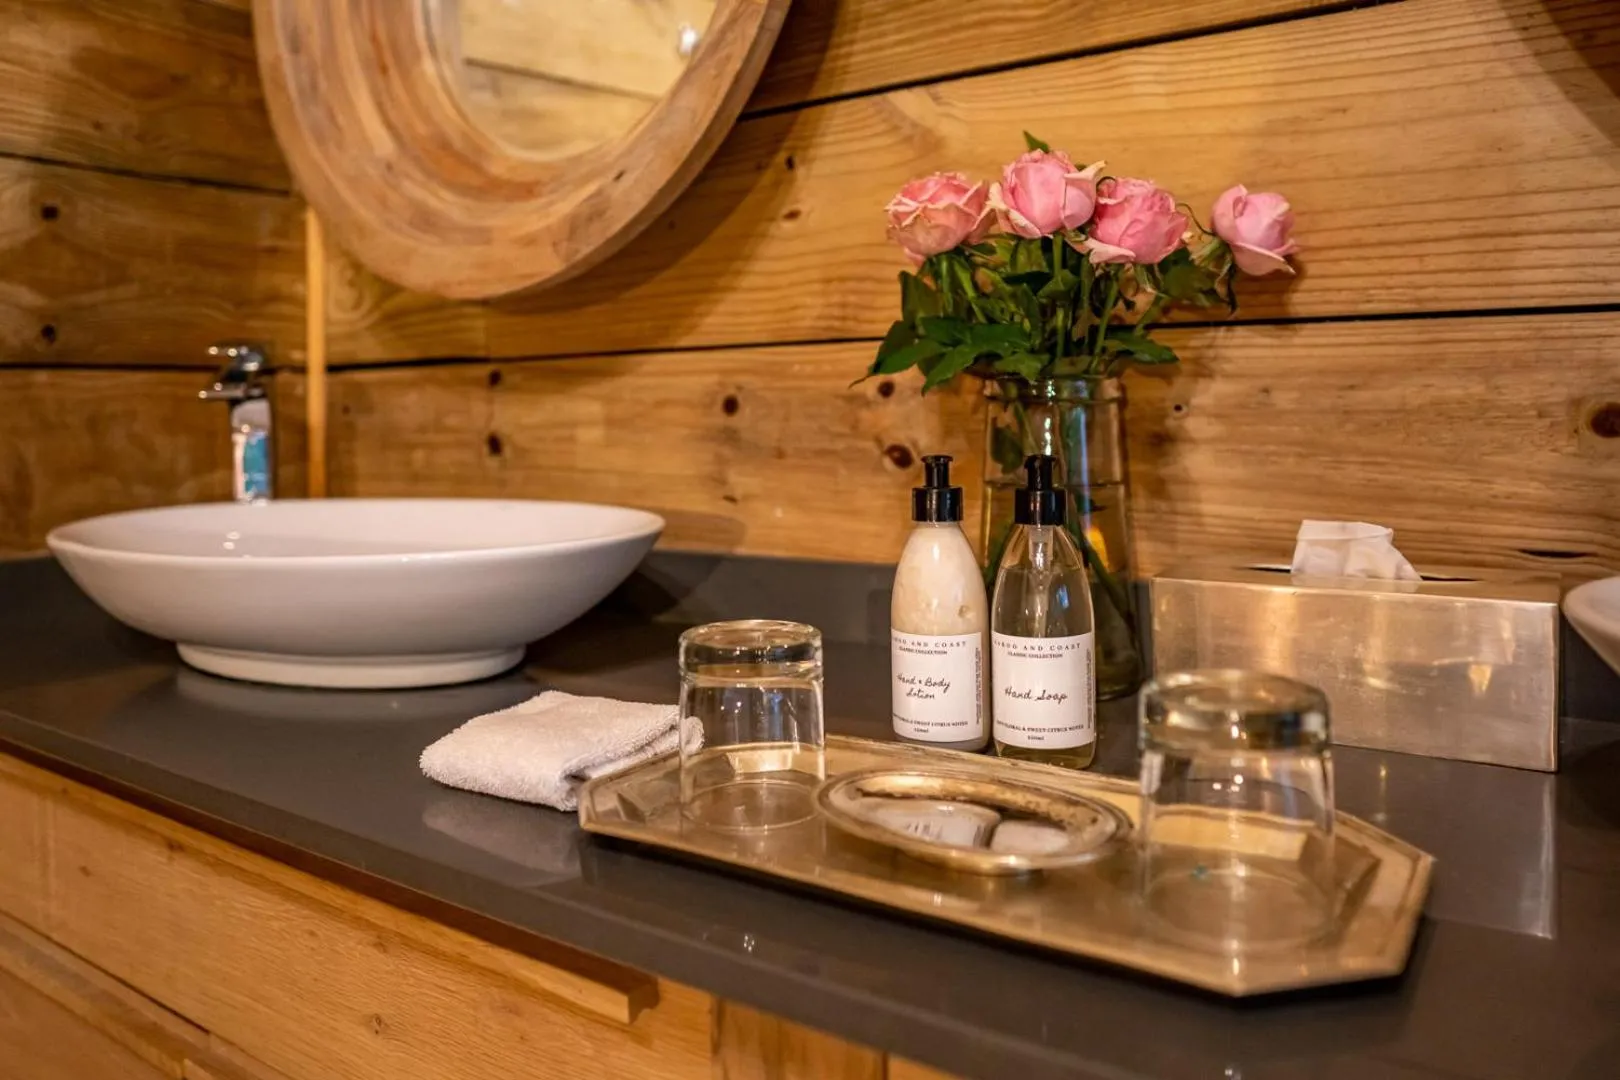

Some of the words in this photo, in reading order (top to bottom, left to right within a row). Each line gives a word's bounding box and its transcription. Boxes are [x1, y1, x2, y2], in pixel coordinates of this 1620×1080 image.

[934, 640, 966, 648] COAST
[1049, 642, 1081, 651] COAST
[924, 676, 951, 694] Body
[905, 687, 935, 700] Lotion
[1004, 685, 1032, 700] Hand
[1034, 689, 1068, 705] Soap
